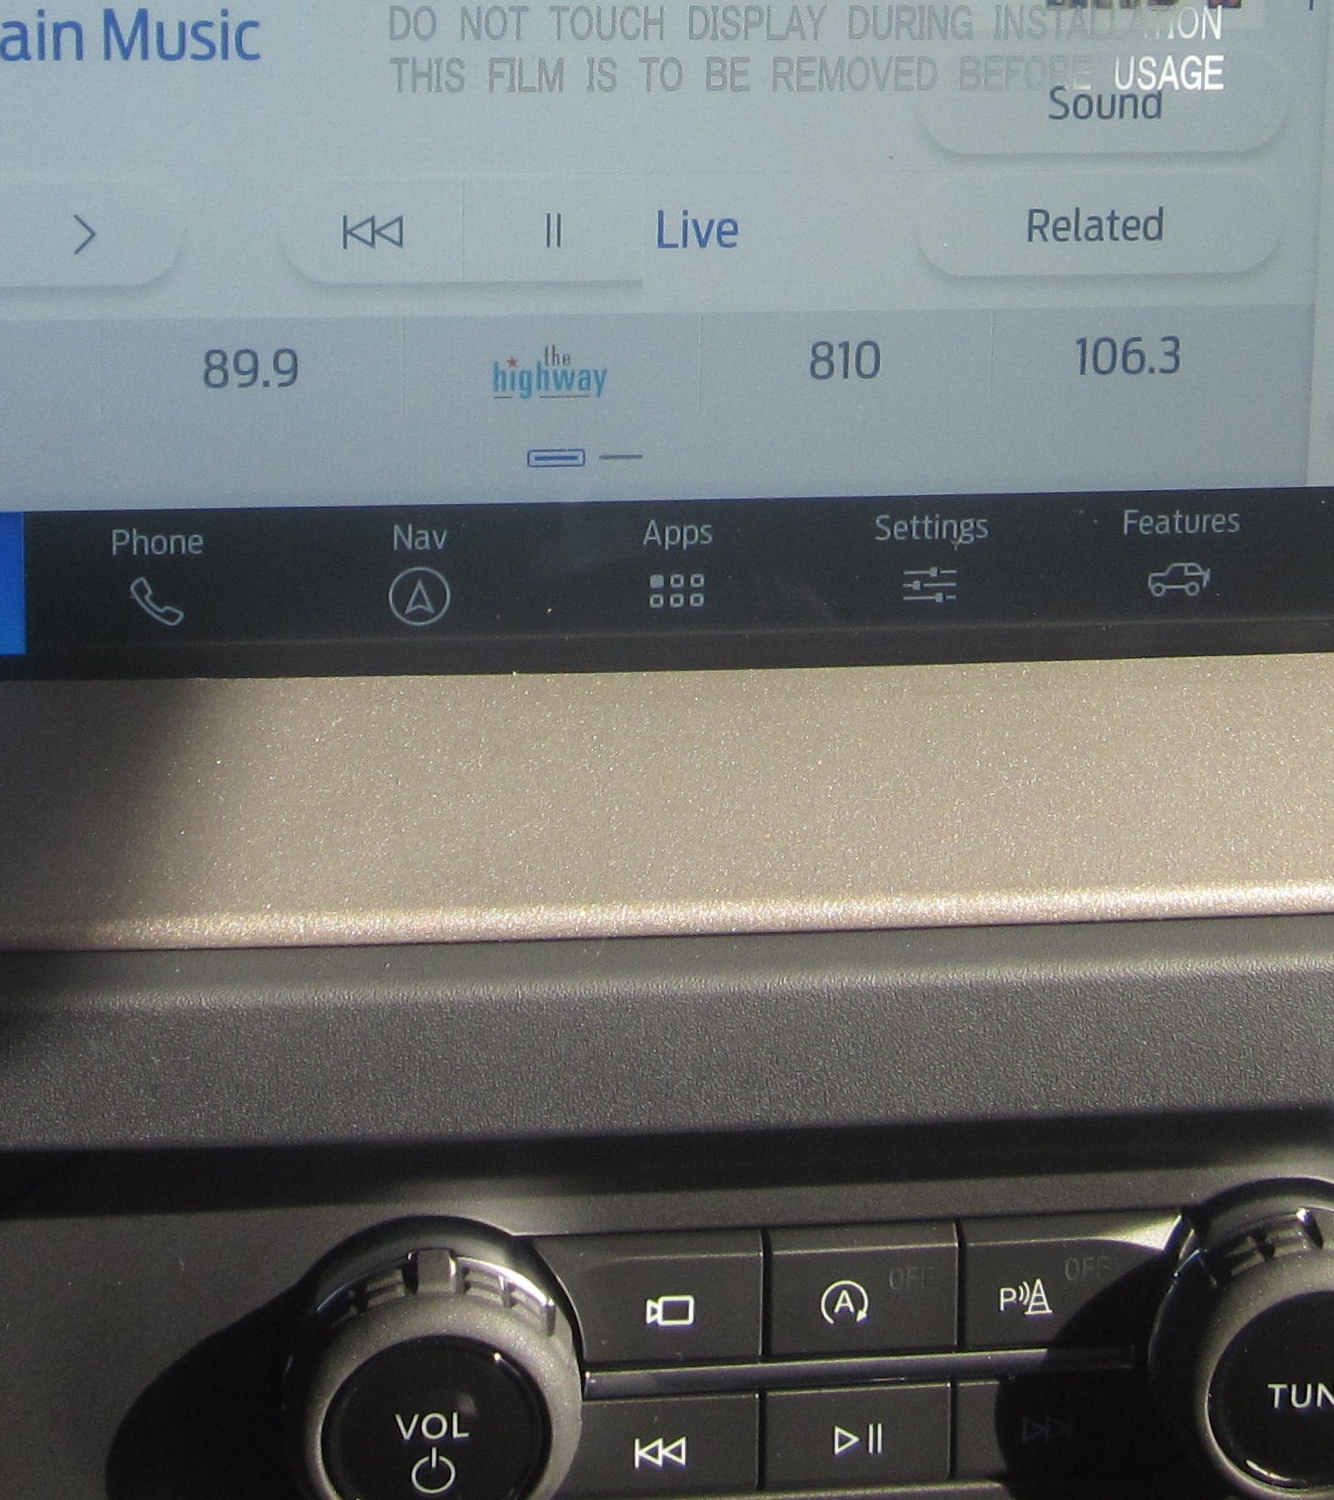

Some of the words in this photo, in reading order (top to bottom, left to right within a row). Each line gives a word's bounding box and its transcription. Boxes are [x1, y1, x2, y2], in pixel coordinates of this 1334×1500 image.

[102, 8, 262, 62] Music
[388, 5, 438, 42] DO
[459, 5, 530, 42] NOT
[548, 5, 665, 42] TOUCH
[688, 5, 828, 42] DISPLAY
[848, 4, 973, 41] DURING
[389, 56, 466, 94] THIS
[487, 56, 565, 94] FILM
[585, 56, 618, 94] IS
[638, 56, 684, 93] TO
[704, 56, 751, 93] BE
[771, 55, 939, 93] REMOVED
[1114, 54, 1225, 91] USAGE
[1048, 85, 1163, 121] Sound
[654, 209, 740, 250] Live
[1025, 207, 1165, 245] Related
[202, 347, 300, 389] 89.9
[543, 345, 572, 368] the
[808, 340, 882, 381] 810
[1074, 335, 1182, 376] 106.3
[492, 358, 609, 399] highway
[392, 523, 448, 552] Nav
[642, 518, 714, 552] Apps
[874, 513, 989, 546] Settings
[1122, 508, 1241, 536] Features
[111, 528, 205, 556] Phone
[395, 1411, 470, 1441] VOL
